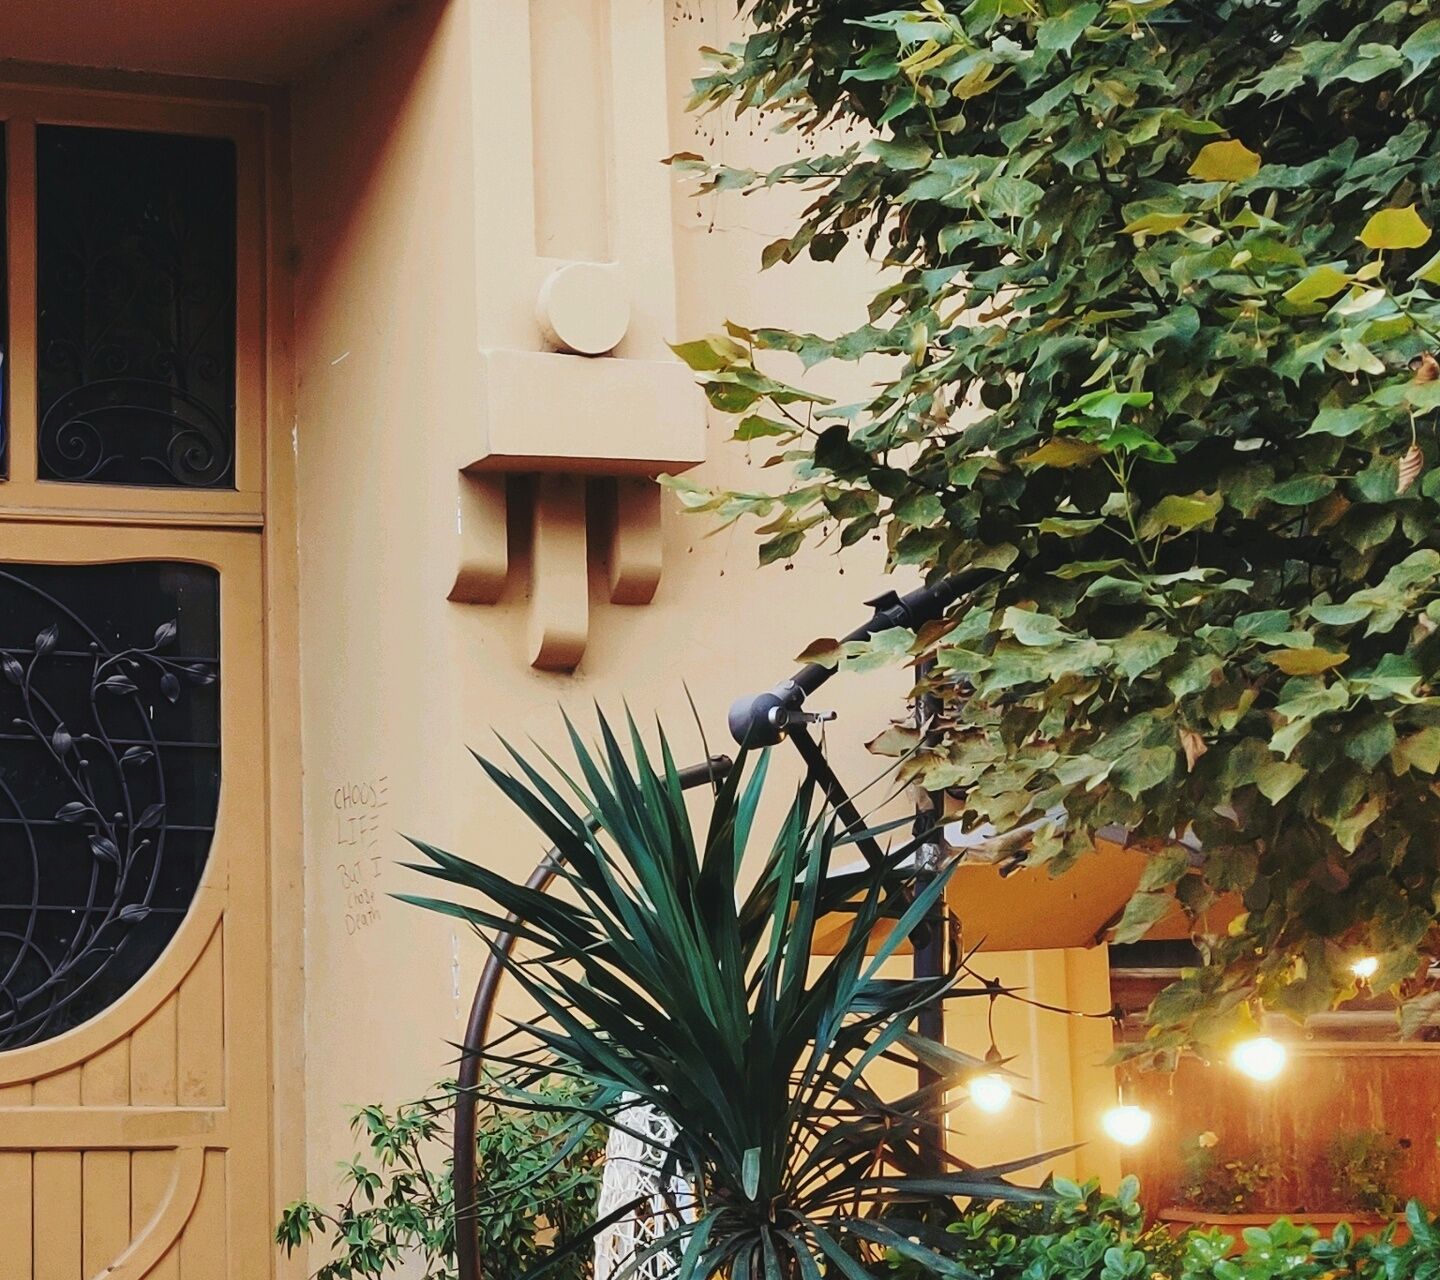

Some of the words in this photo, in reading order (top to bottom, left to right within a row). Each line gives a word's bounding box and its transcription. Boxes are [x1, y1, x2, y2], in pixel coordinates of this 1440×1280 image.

[334, 776, 388, 810] CHOOSE
[337, 815, 379, 847] LIFE
[371, 856, 382, 878] I
